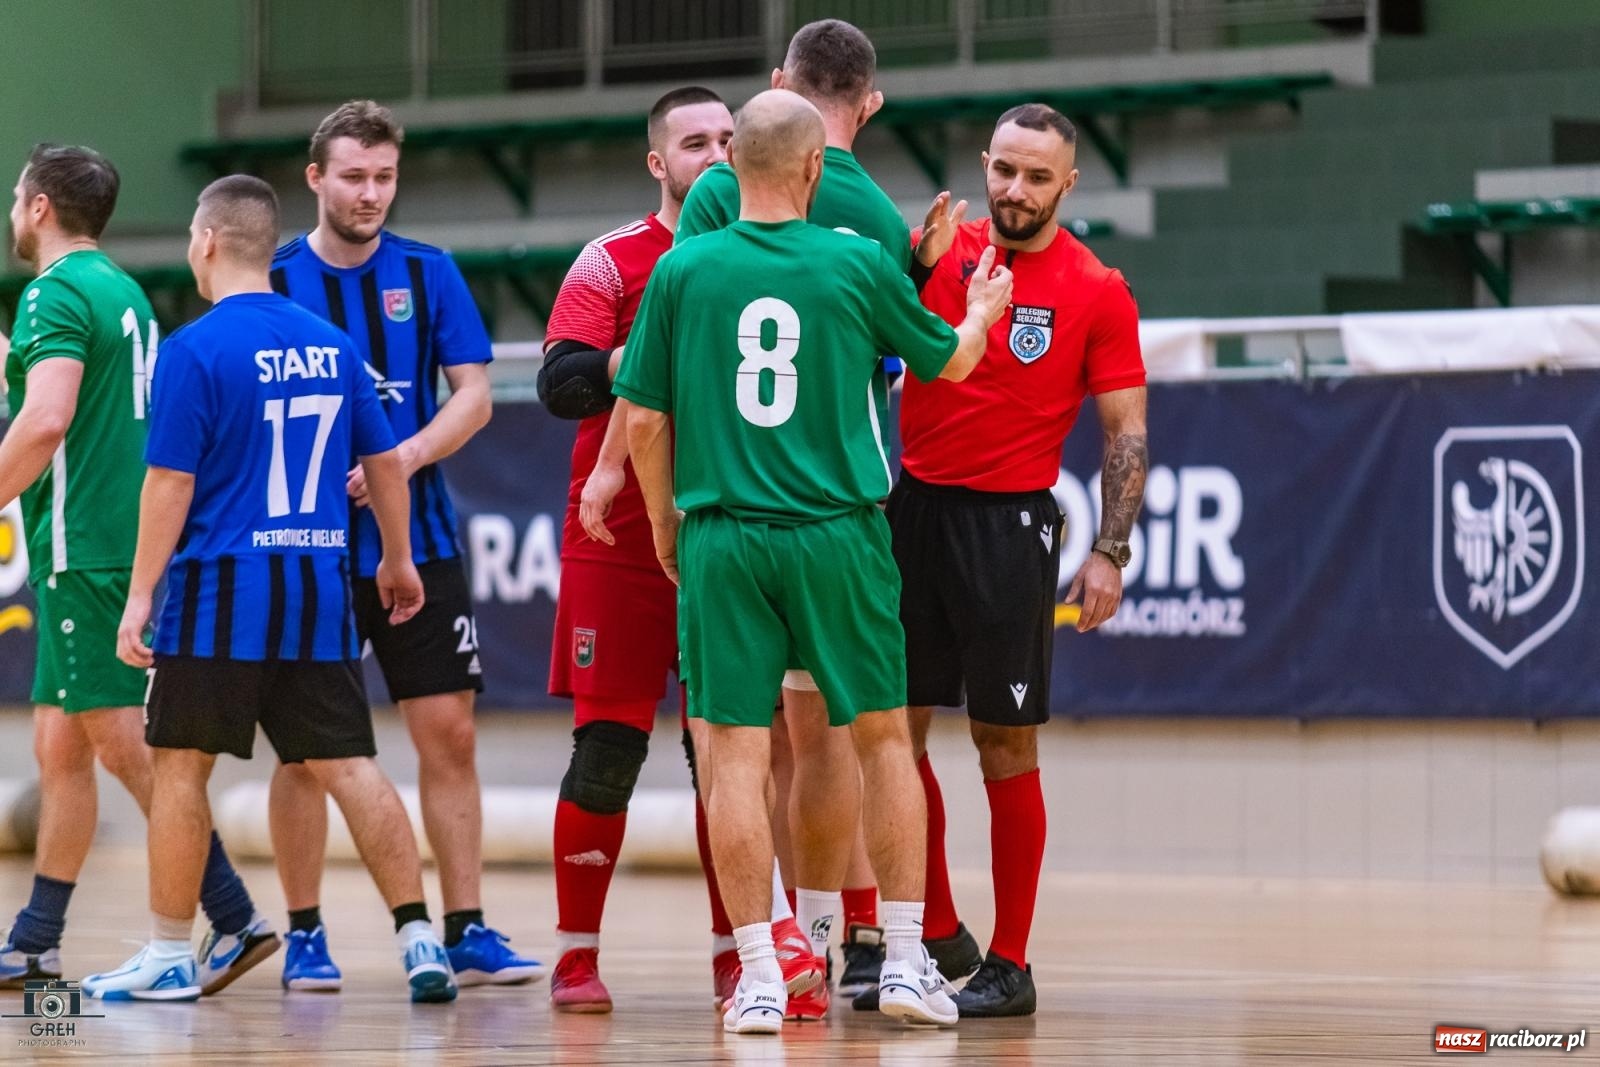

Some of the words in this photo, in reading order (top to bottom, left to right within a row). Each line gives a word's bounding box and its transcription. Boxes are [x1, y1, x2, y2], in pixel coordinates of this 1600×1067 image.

[1016, 306, 1052, 318] KOLEGIUM
[254, 346, 340, 383] START
[736, 297, 800, 427] 8
[263, 394, 344, 518] 17
[753, 995, 777, 1003] joma
